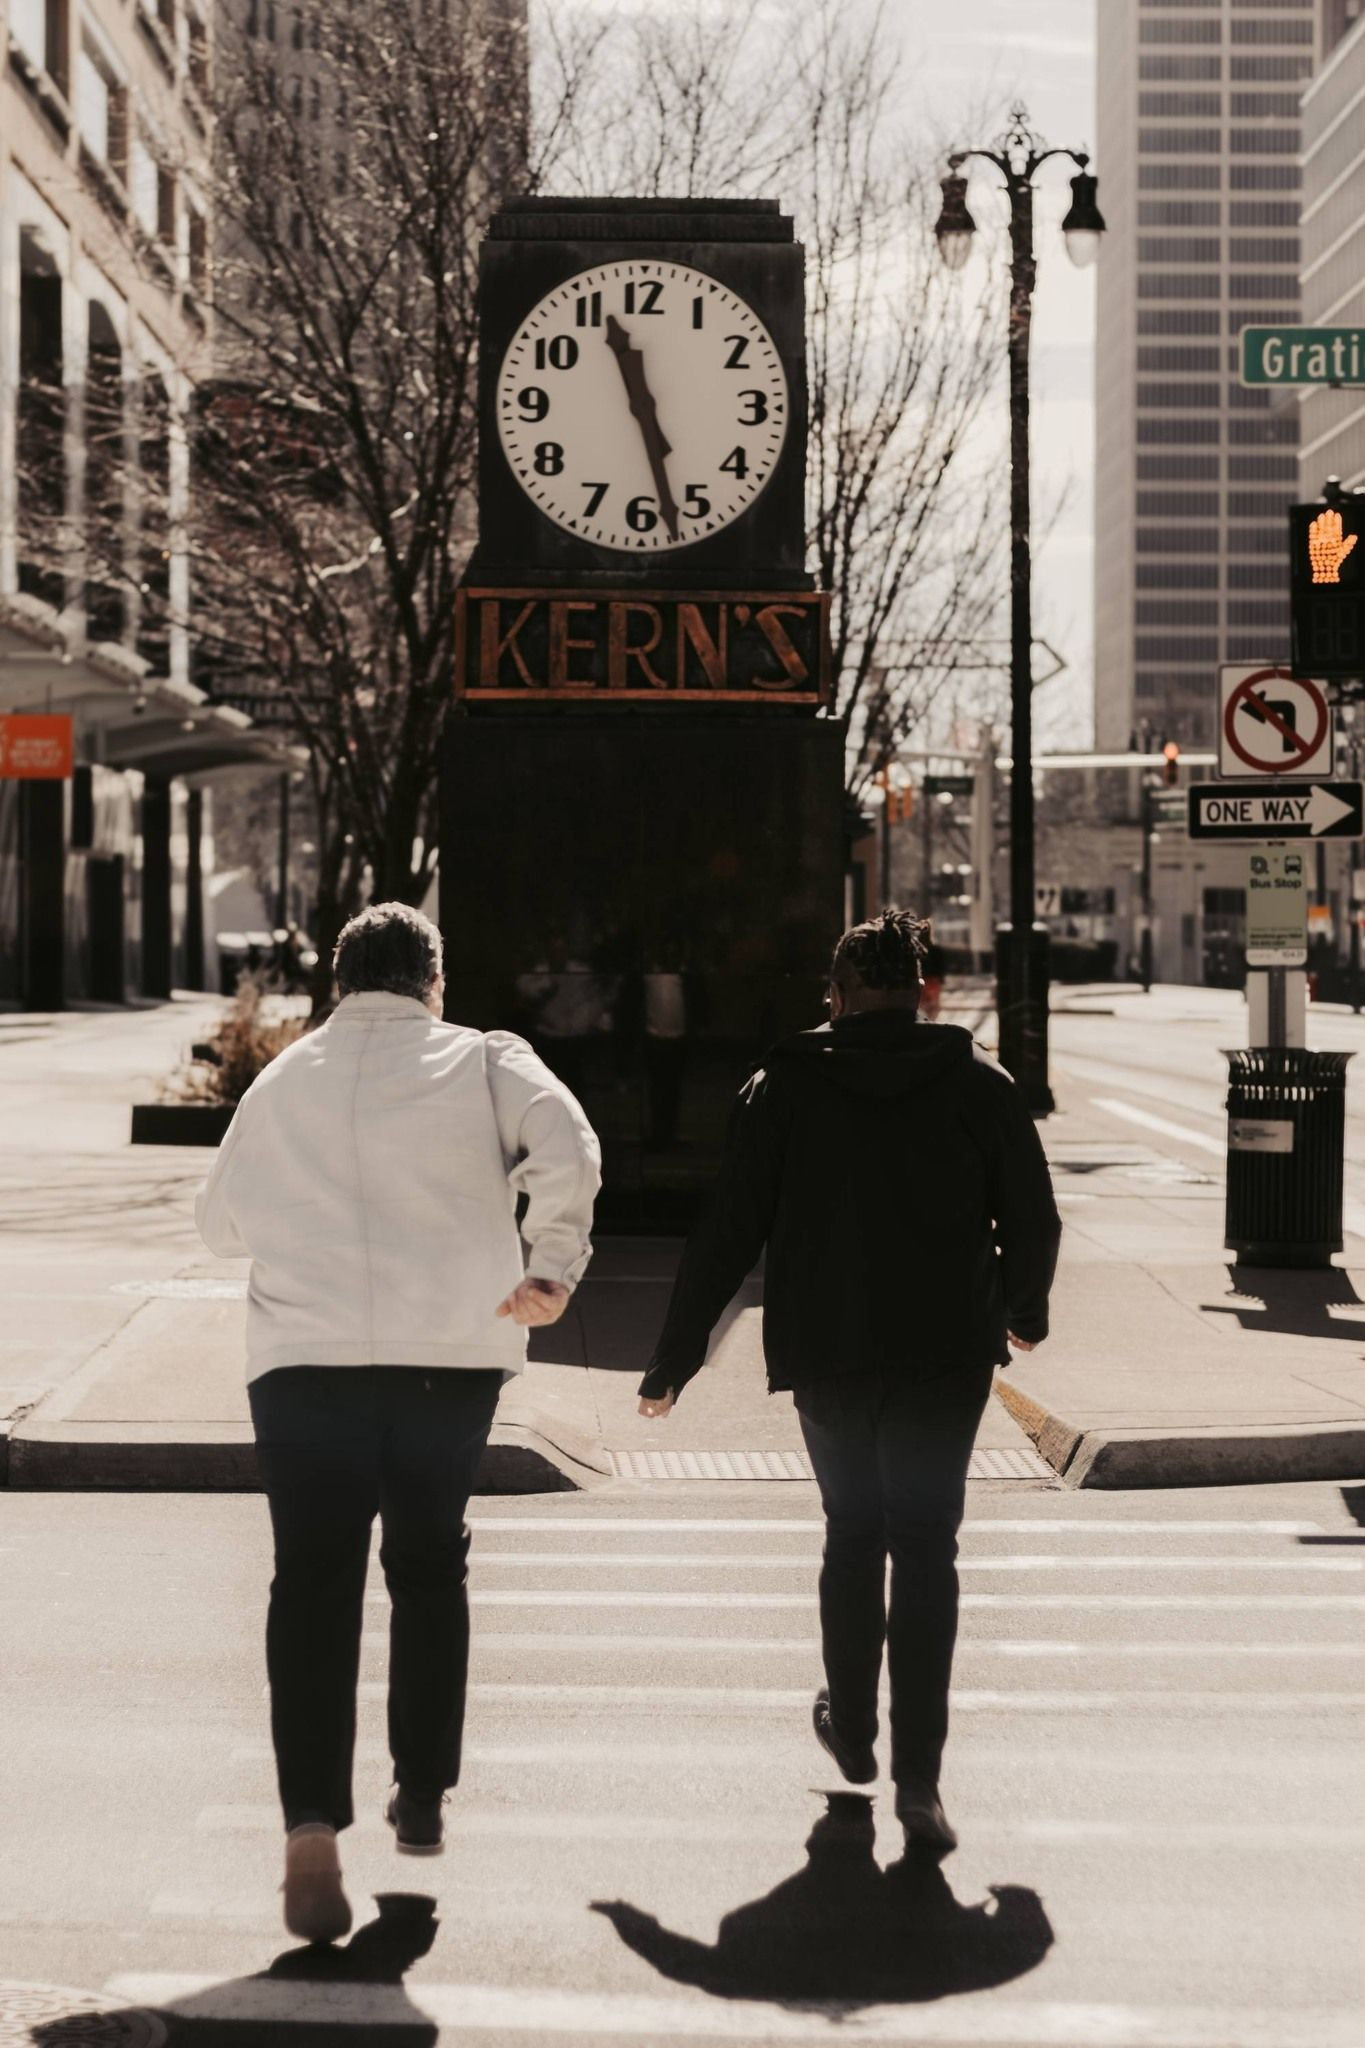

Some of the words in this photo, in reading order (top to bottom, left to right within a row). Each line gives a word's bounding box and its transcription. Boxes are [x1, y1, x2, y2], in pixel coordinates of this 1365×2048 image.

[576, 291, 602, 328] 11
[624, 280, 665, 315] 12
[692, 296, 703, 330] 1
[535, 334, 579, 370] 10
[724, 335, 750, 370] 2
[1262, 334, 1365, 378] Grati
[517, 386, 550, 423] 9
[737, 389, 769, 426] 3
[533, 441, 564, 477] 8
[719, 445, 750, 480] 4
[581, 482, 610, 518] 7
[625, 496, 658, 533] 6
[682, 484, 711, 520] 5
[480, 600, 808, 689] KERN'S
[1206, 800, 1253, 822] ONE
[1262, 799, 1310, 821] WAY
[1250, 877, 1271, 889] Bus
[1274, 877, 1302, 890] Stop
